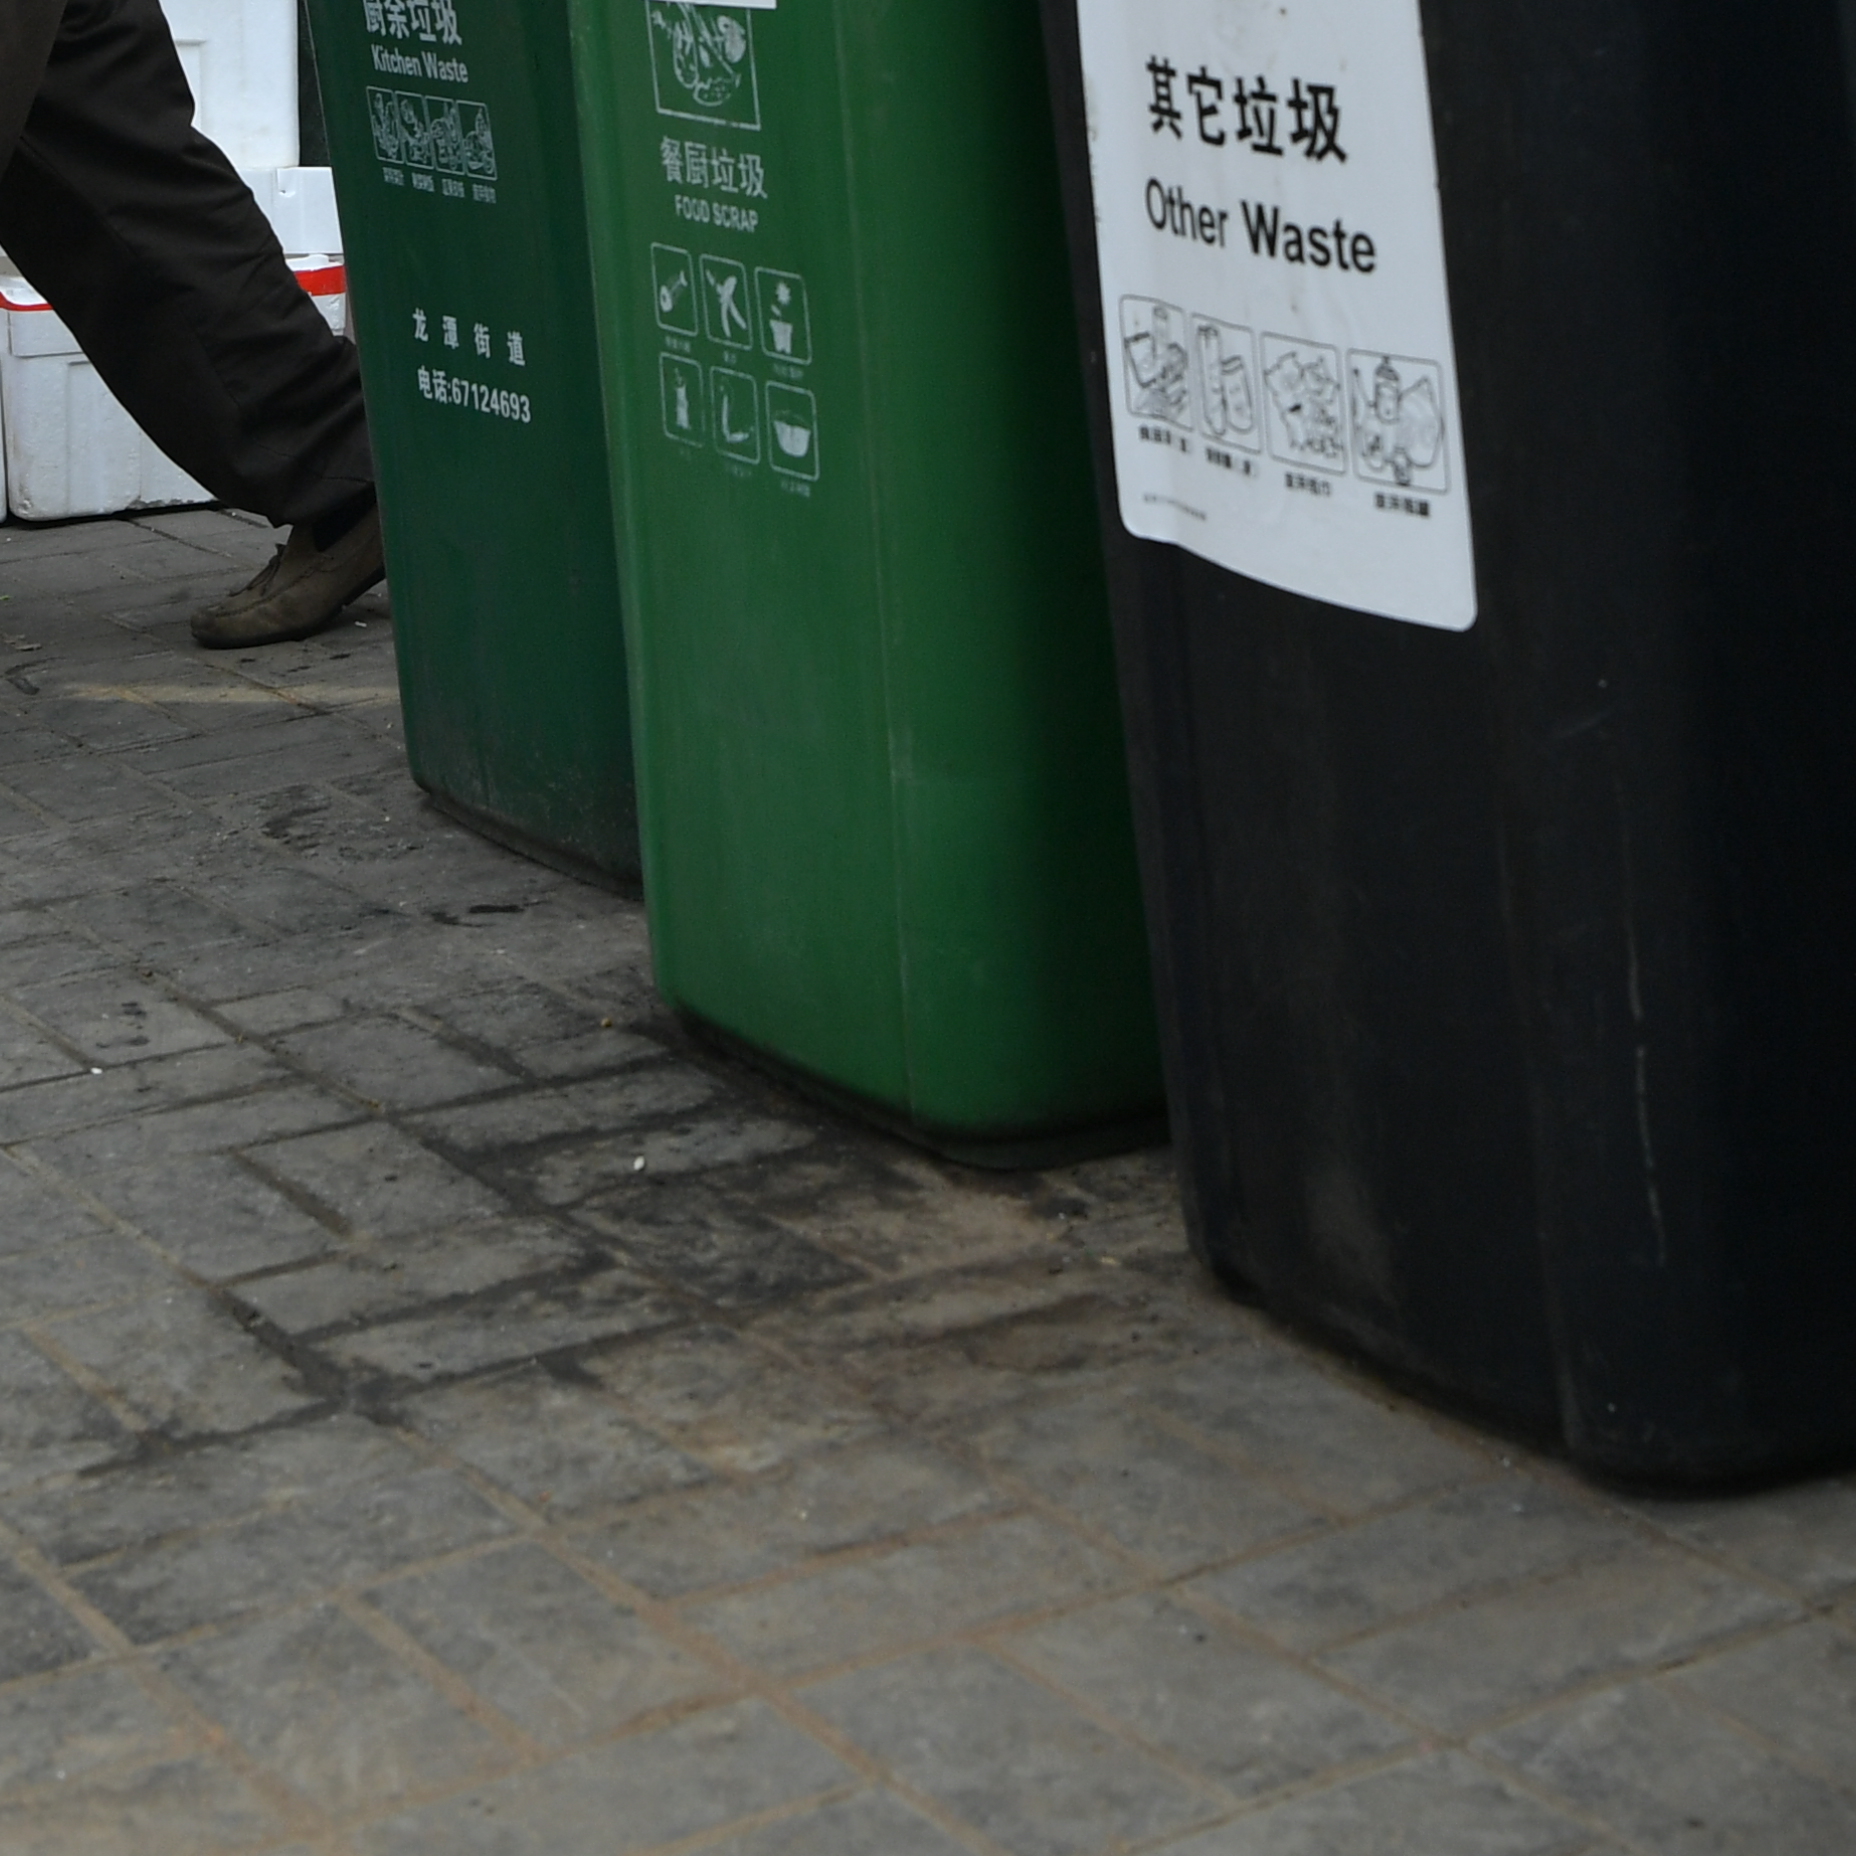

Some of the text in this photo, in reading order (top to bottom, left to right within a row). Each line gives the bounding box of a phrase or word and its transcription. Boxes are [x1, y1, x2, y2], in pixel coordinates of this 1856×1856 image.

[370, 48, 469, 85] Kitchen Waste
[1145, 56, 1349, 164] 其它垃圾
[659, 135, 768, 201] 餐厨垃圾
[674, 193, 759, 234] FOOD SCRAP
[1145, 177, 1377, 274] Other Waste
[412, 307, 527, 368] 龙潭街道
